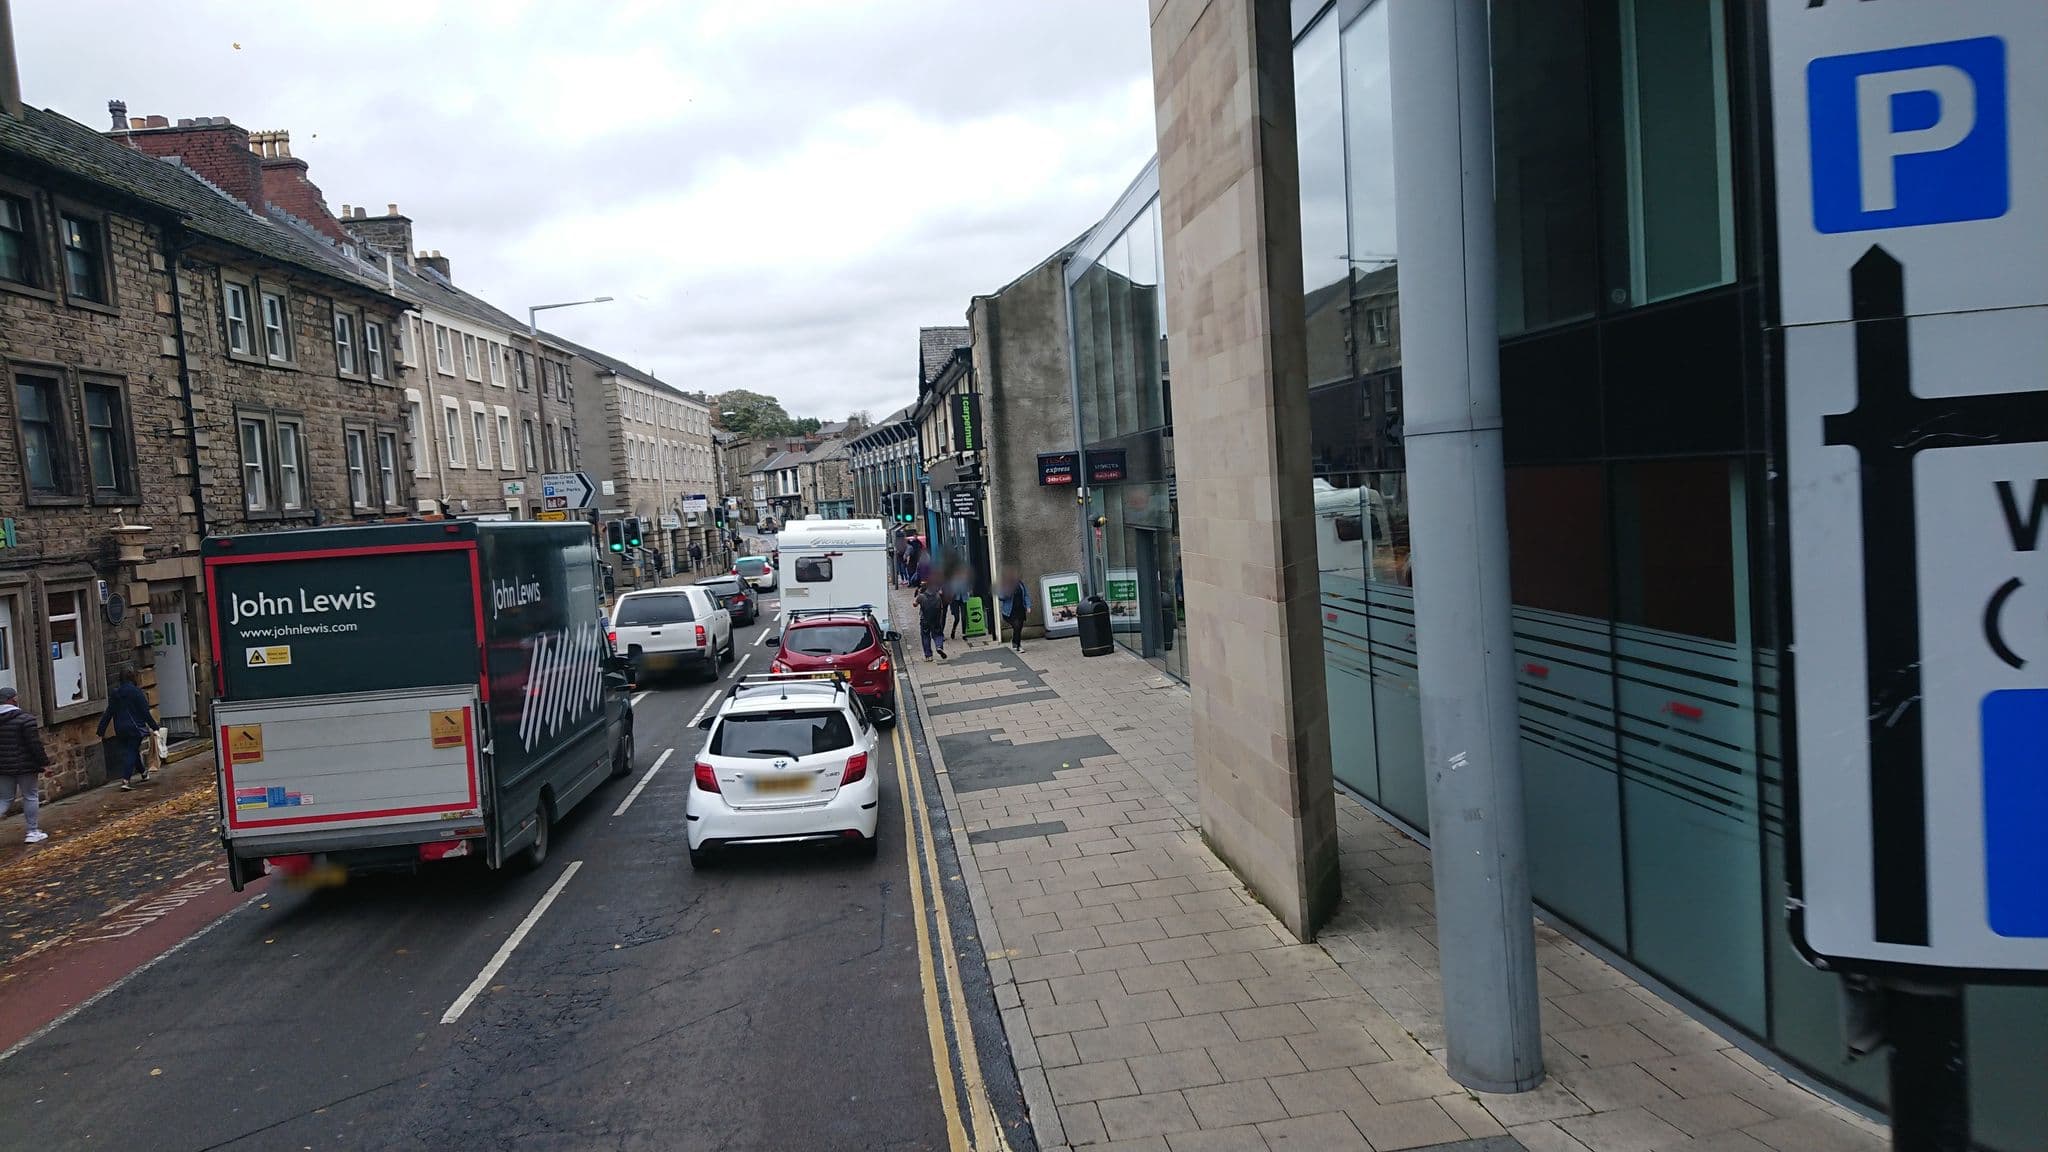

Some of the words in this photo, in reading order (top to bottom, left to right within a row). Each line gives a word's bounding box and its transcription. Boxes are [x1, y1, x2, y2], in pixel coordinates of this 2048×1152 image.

[1855, 63, 1977, 213] P
[962, 400, 973, 449] carpetman
[1045, 465, 1070, 474] express
[546, 487, 553, 496] P
[230, 591, 293, 626] John
[299, 585, 376, 614] Lewis
[492, 579, 516, 620] John
[515, 574, 541, 606] Lewis
[240, 623, 358, 639] www.johnlewis.com
